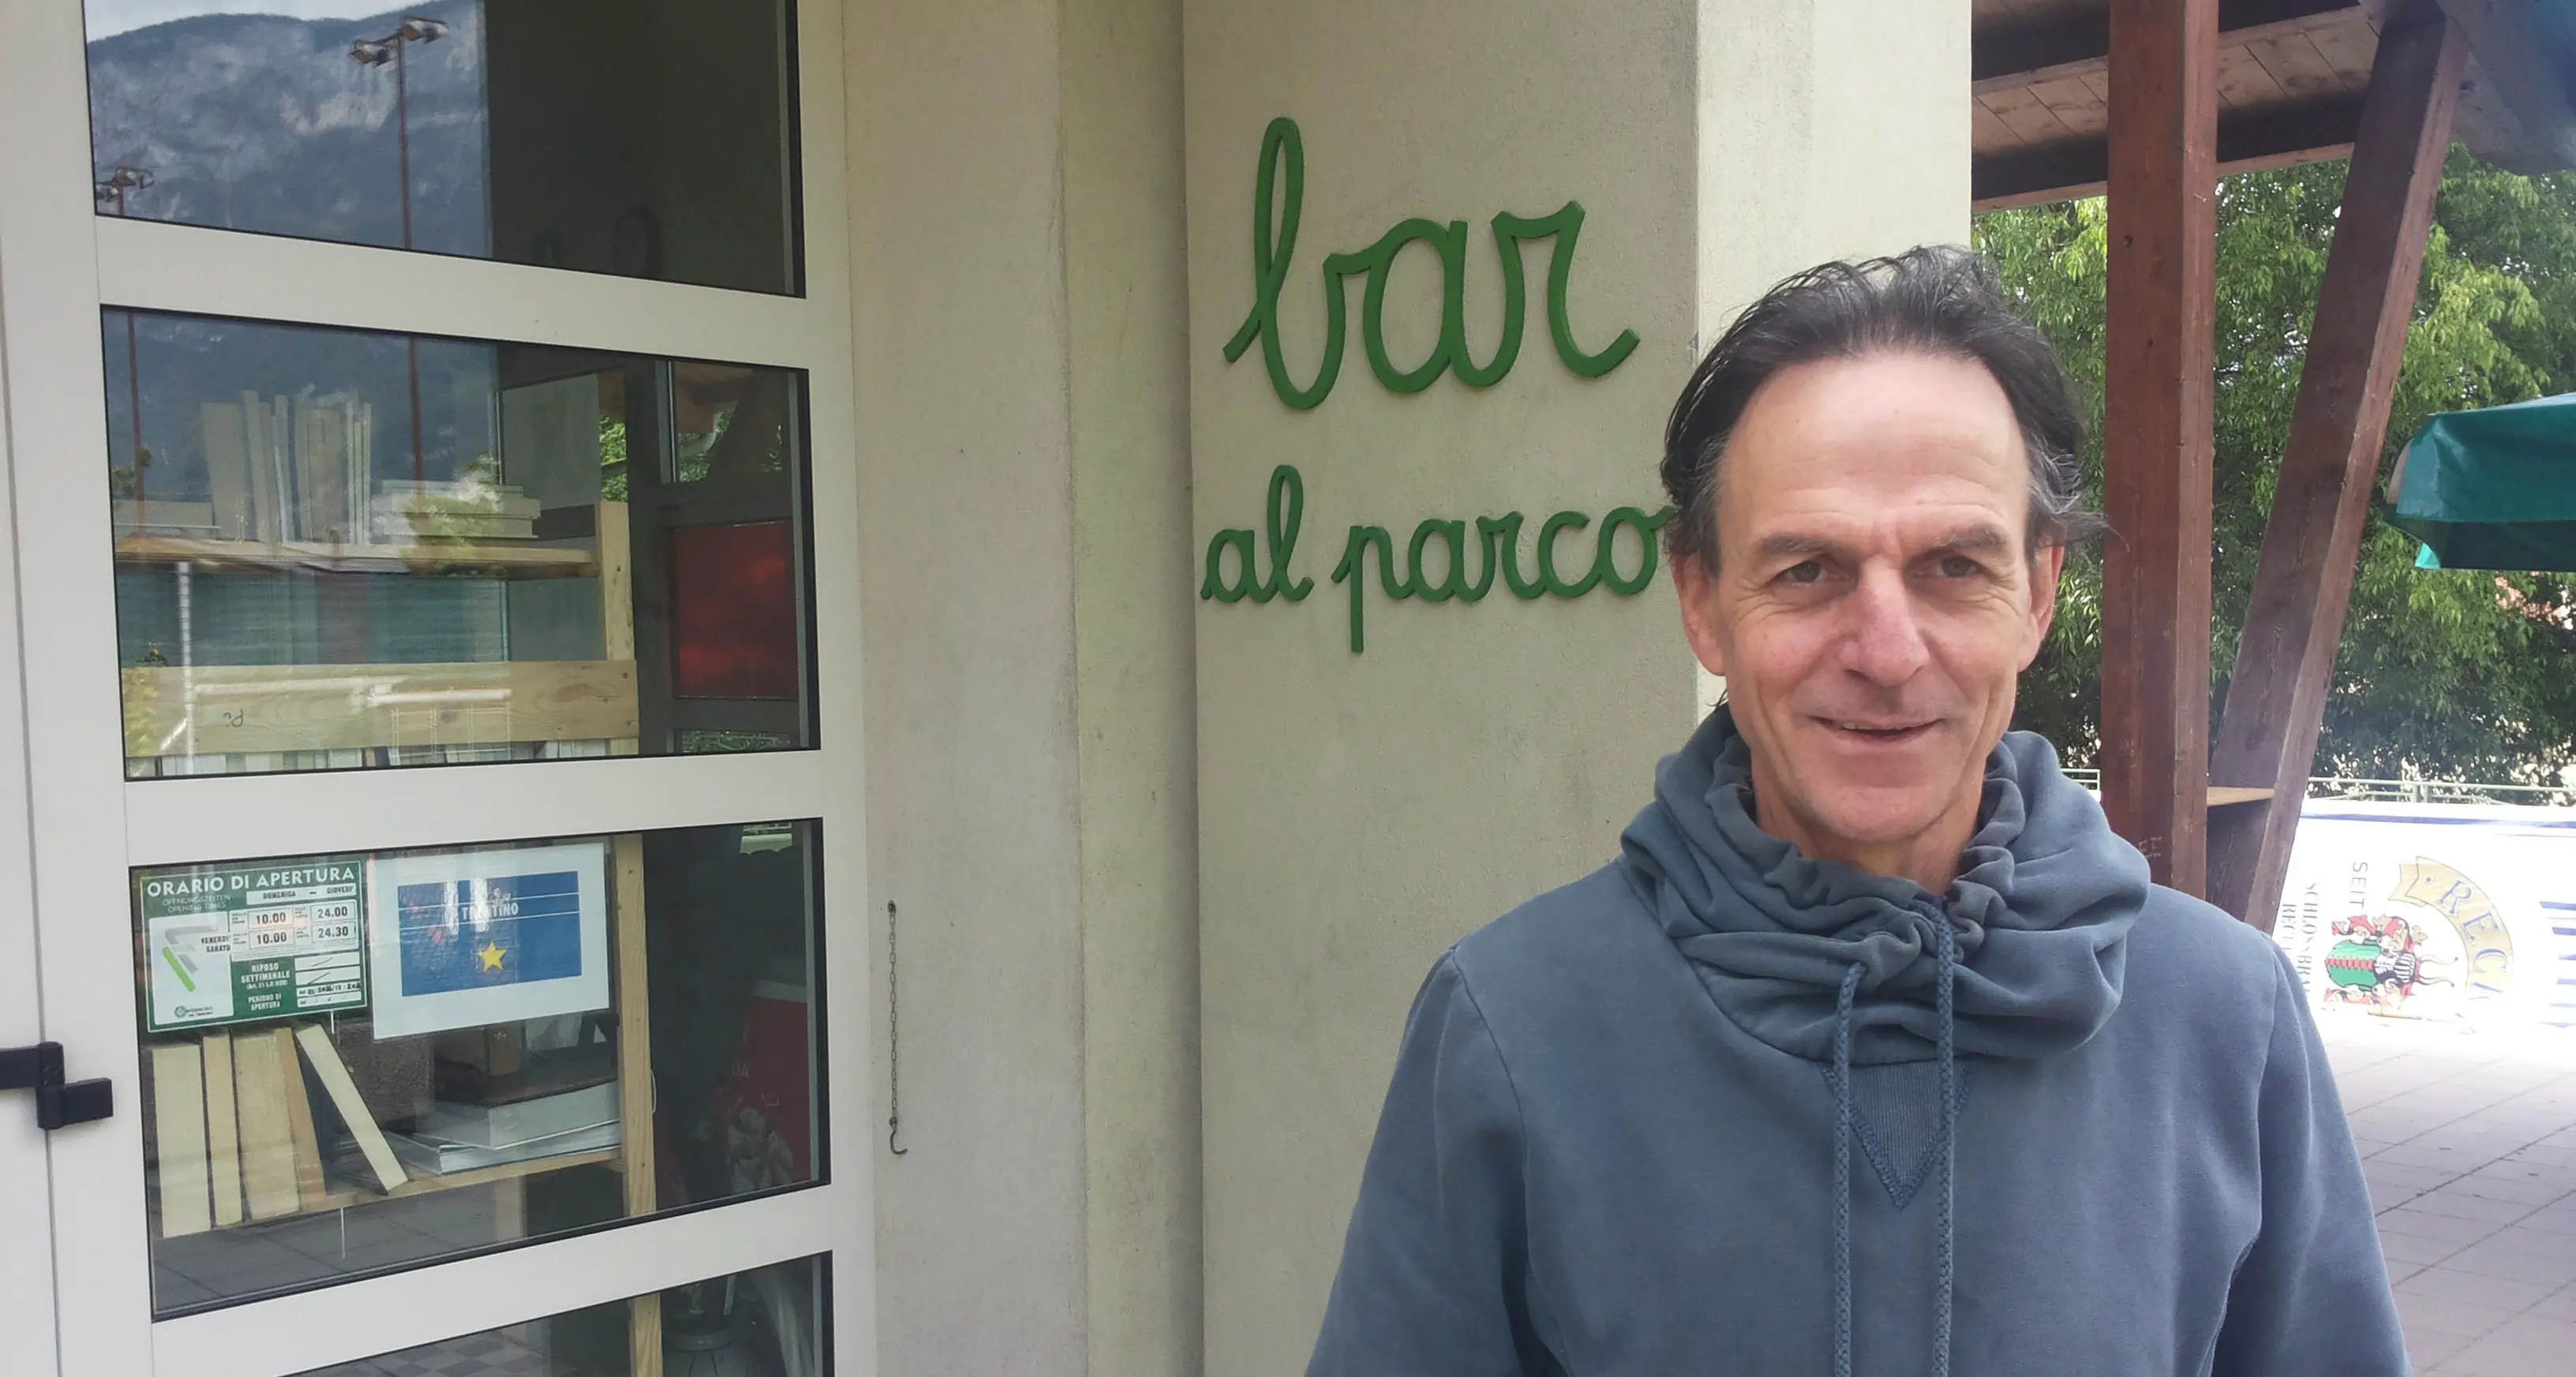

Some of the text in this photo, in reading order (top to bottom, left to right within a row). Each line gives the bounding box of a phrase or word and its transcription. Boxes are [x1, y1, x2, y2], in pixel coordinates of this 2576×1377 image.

[1222, 117, 1640, 410] bar
[1200, 464, 1676, 653] al parco
[147, 866, 355, 897] ORARIO DI APERTURA
[2349, 862, 2368, 908] SEIT
[256, 911, 286, 924] 10.00
[317, 906, 348, 919] 24.00
[257, 932, 286, 945] 10.00
[318, 926, 348, 938] 24.30
[241, 971, 290, 983] SETTIMANALE
[252, 963, 279, 972] RIPOSO
